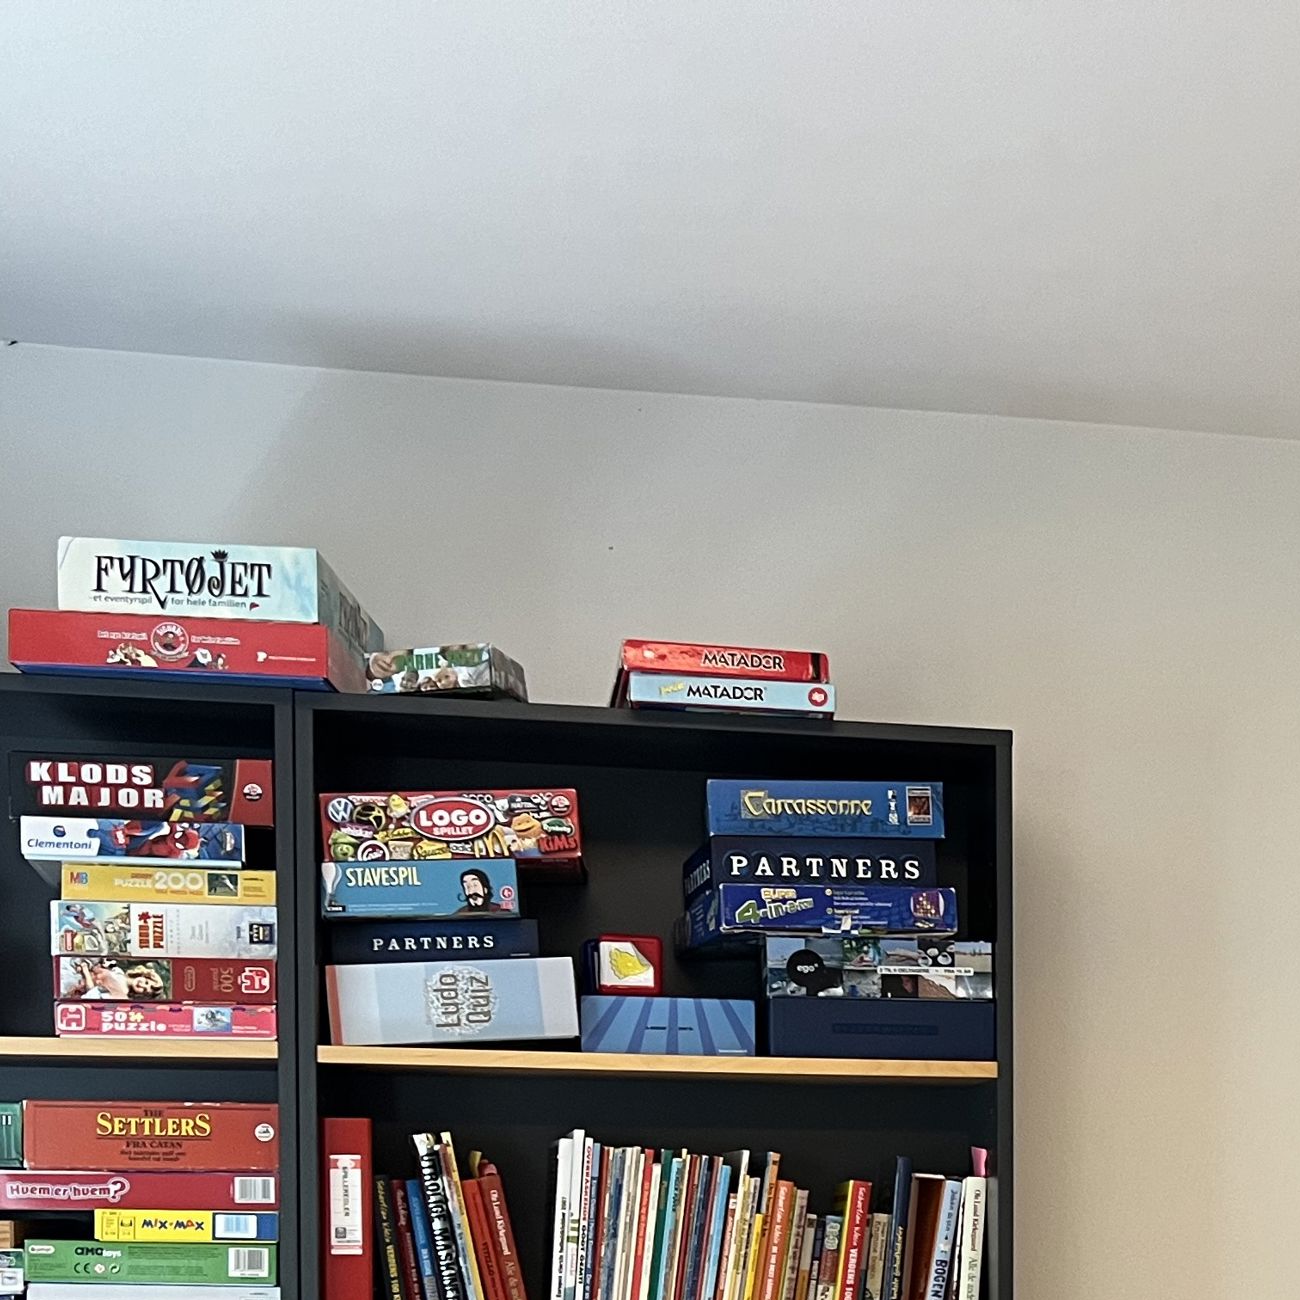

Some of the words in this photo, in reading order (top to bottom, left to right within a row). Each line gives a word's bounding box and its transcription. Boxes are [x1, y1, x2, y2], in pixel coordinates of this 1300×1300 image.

[91, 553, 271, 608] FYRTØJET
[701, 650, 784, 671] MATADOR
[687, 684, 765, 702] MATADOR
[30, 761, 152, 785] KLODS
[42, 786, 164, 808] MAJOR
[419, 809, 488, 826] LOGO
[27, 838, 91, 850] Clementoni
[346, 867, 421, 887] STAVESPIL
[729, 855, 920, 880] PARTNERS
[155, 872, 203, 889] 200
[373, 936, 495, 950] PARTNERS
[102, 1020, 167, 1032] puzzle
[96, 1112, 211, 1137] SETTLERS
[385, 1244, 397, 1277] VERDENS
[845, 1248, 858, 1285] VERDENS
[967, 1256, 977, 1271] Alle
[930, 1258, 947, 1298] BOGEN
[968, 1274, 976, 1282] de
[843, 1286, 853, 1300] 100
